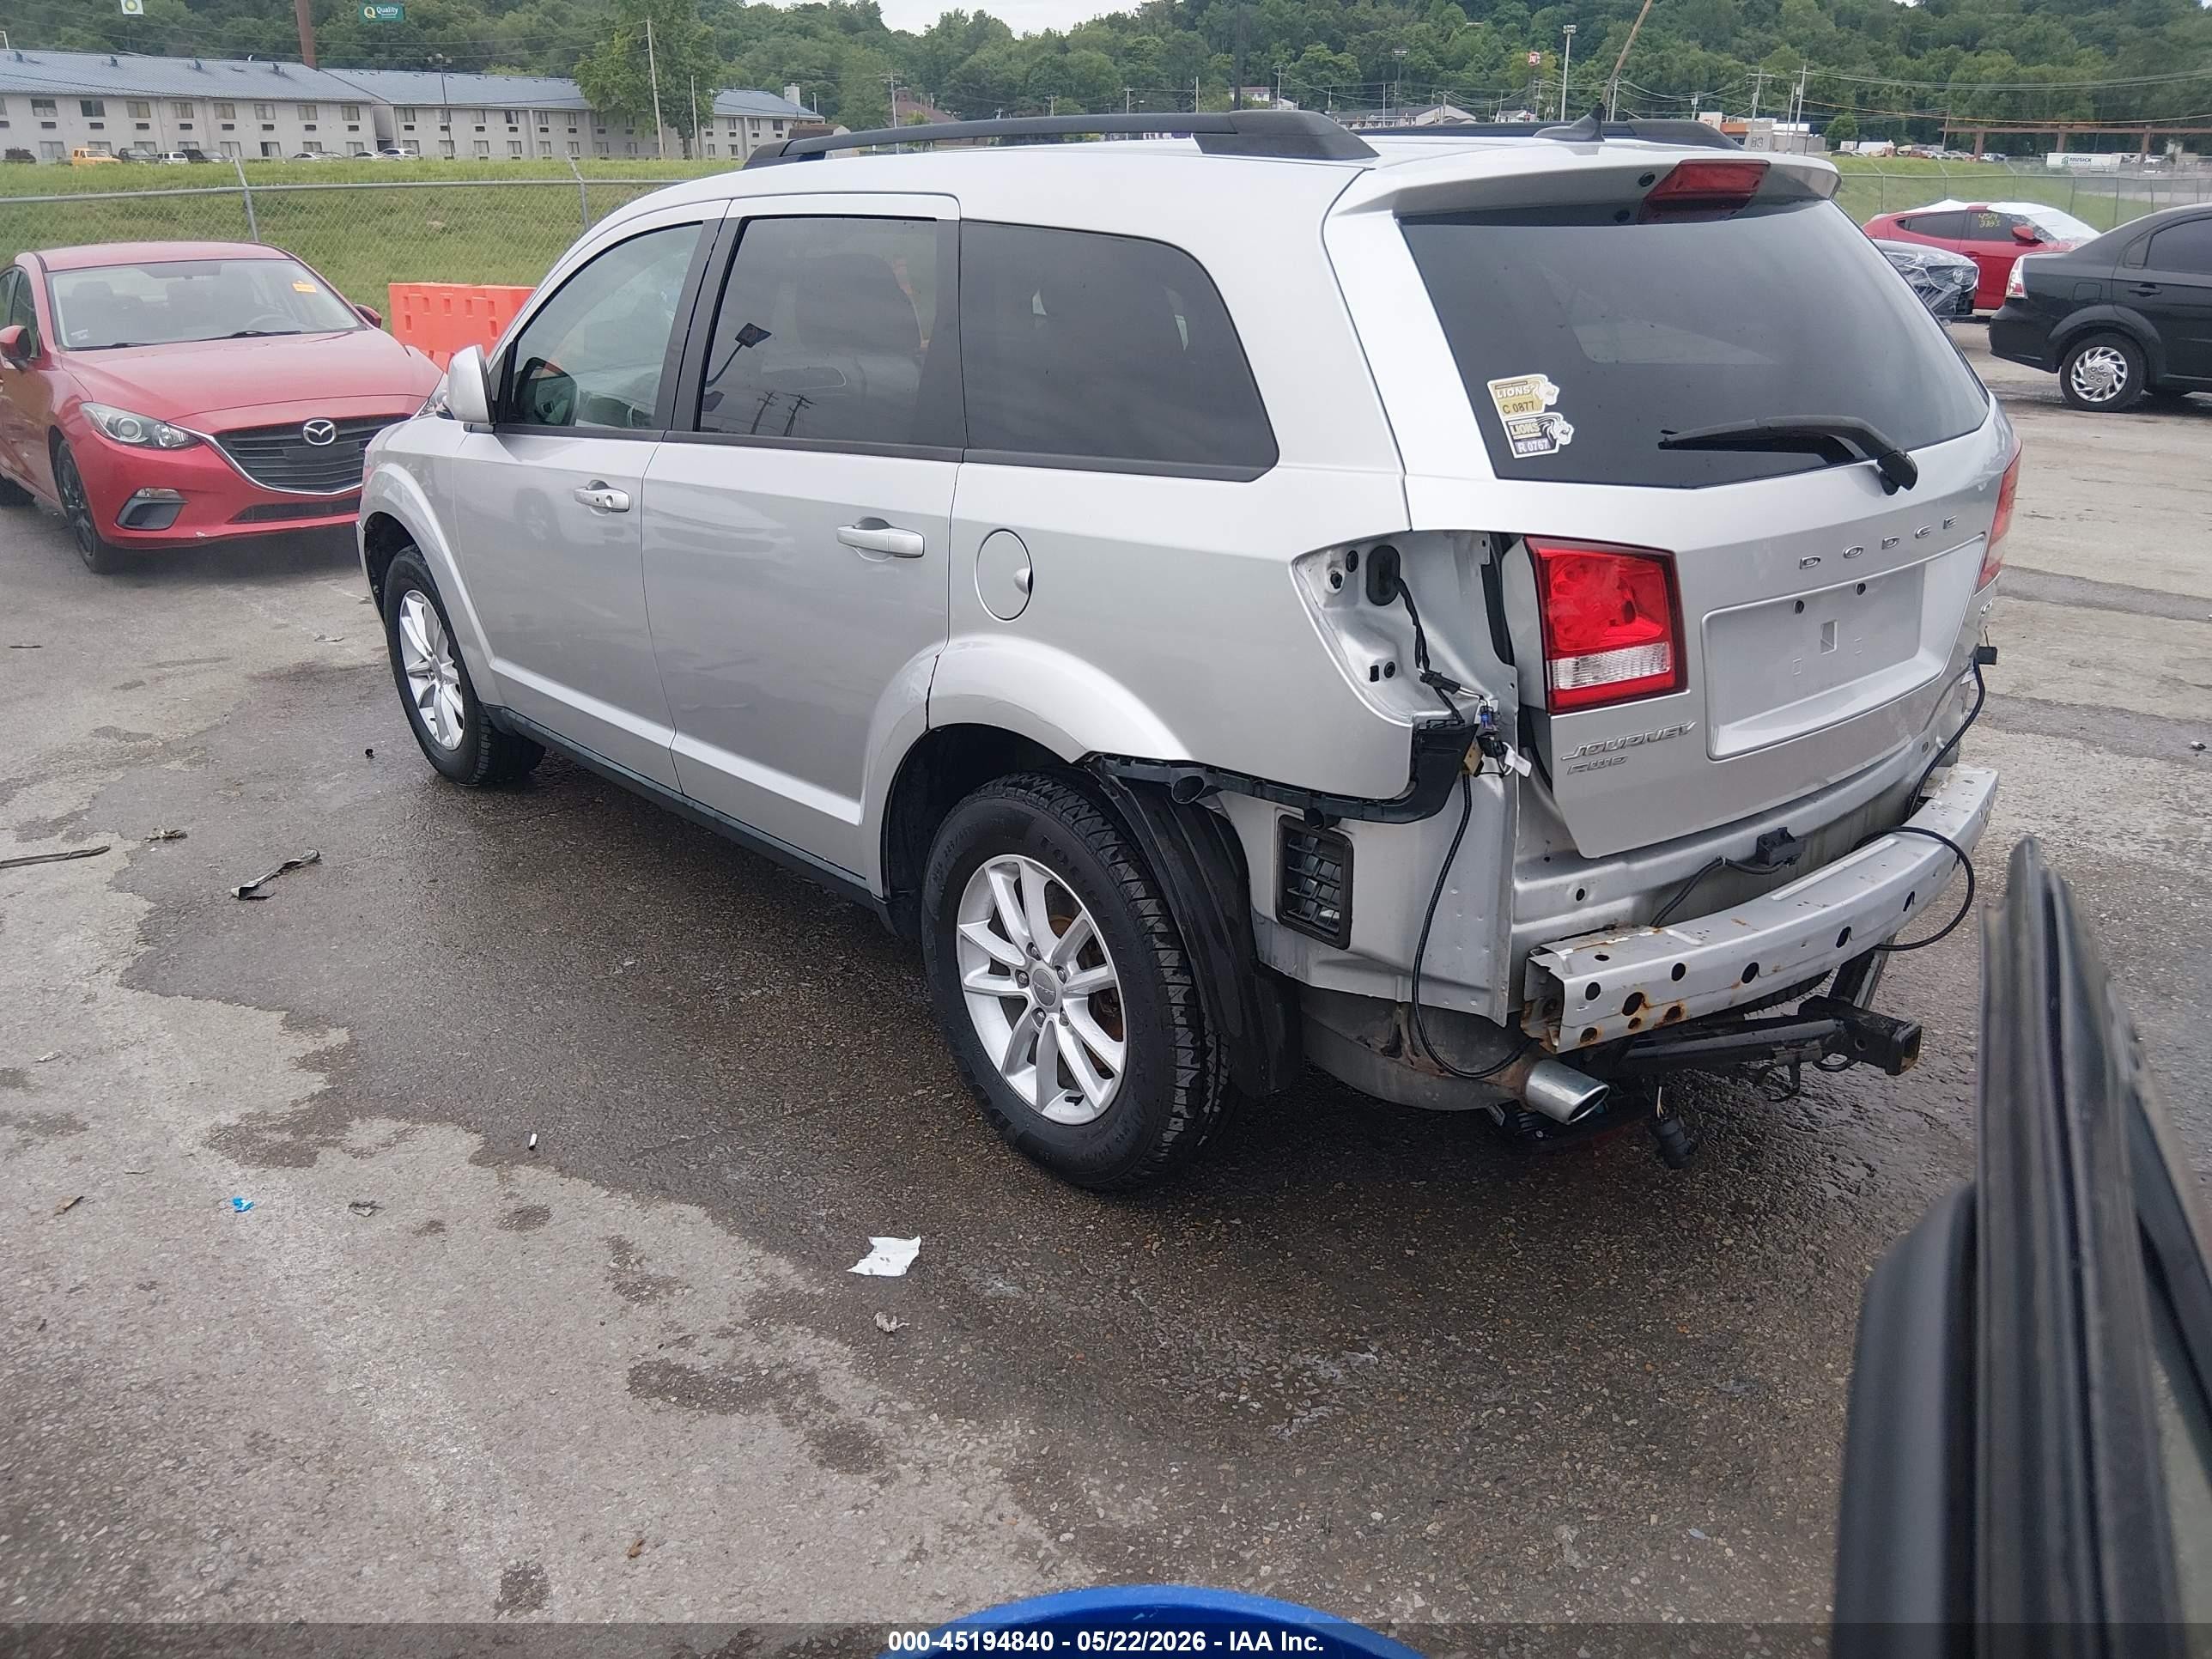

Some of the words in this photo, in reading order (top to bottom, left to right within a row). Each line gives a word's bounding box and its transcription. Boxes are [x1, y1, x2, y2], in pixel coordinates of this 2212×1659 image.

[1497, 385, 1530, 398] LIONS
[1503, 404, 1510, 414] C
[1513, 401, 1534, 413] 0877
[1510, 422, 1540, 435] LIONS
[1517, 442, 1527, 453] R
[1528, 439, 1548, 452] 0767
[1799, 515, 1958, 569] DODGE
[1560, 721, 1697, 761] JOURNEY
